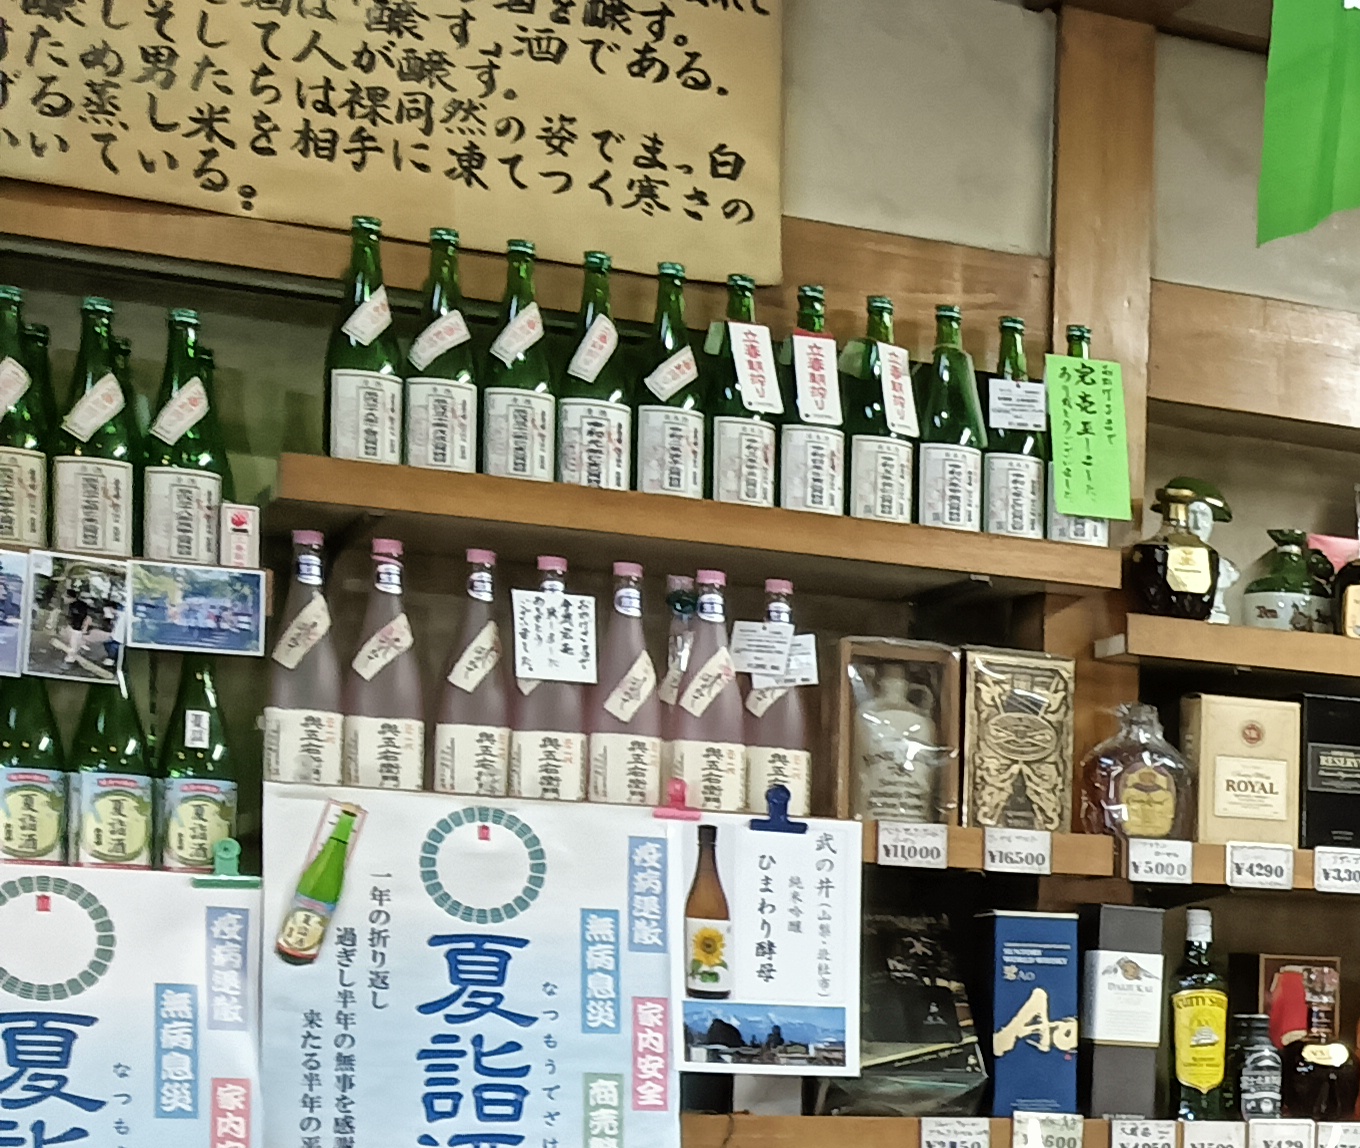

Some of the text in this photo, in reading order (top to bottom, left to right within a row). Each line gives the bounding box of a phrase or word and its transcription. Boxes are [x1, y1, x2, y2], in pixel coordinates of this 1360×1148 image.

[1225, 779, 1278, 795] ROYAL
[367, 870, 393, 1010] 一年の折り返し
[585, 914, 617, 1029] 無病息災
[754, 854, 779, 983] ひまわり酵母
[159, 988, 194, 1114] 無病息災
[636, 1002, 665, 1107] 家内安全
